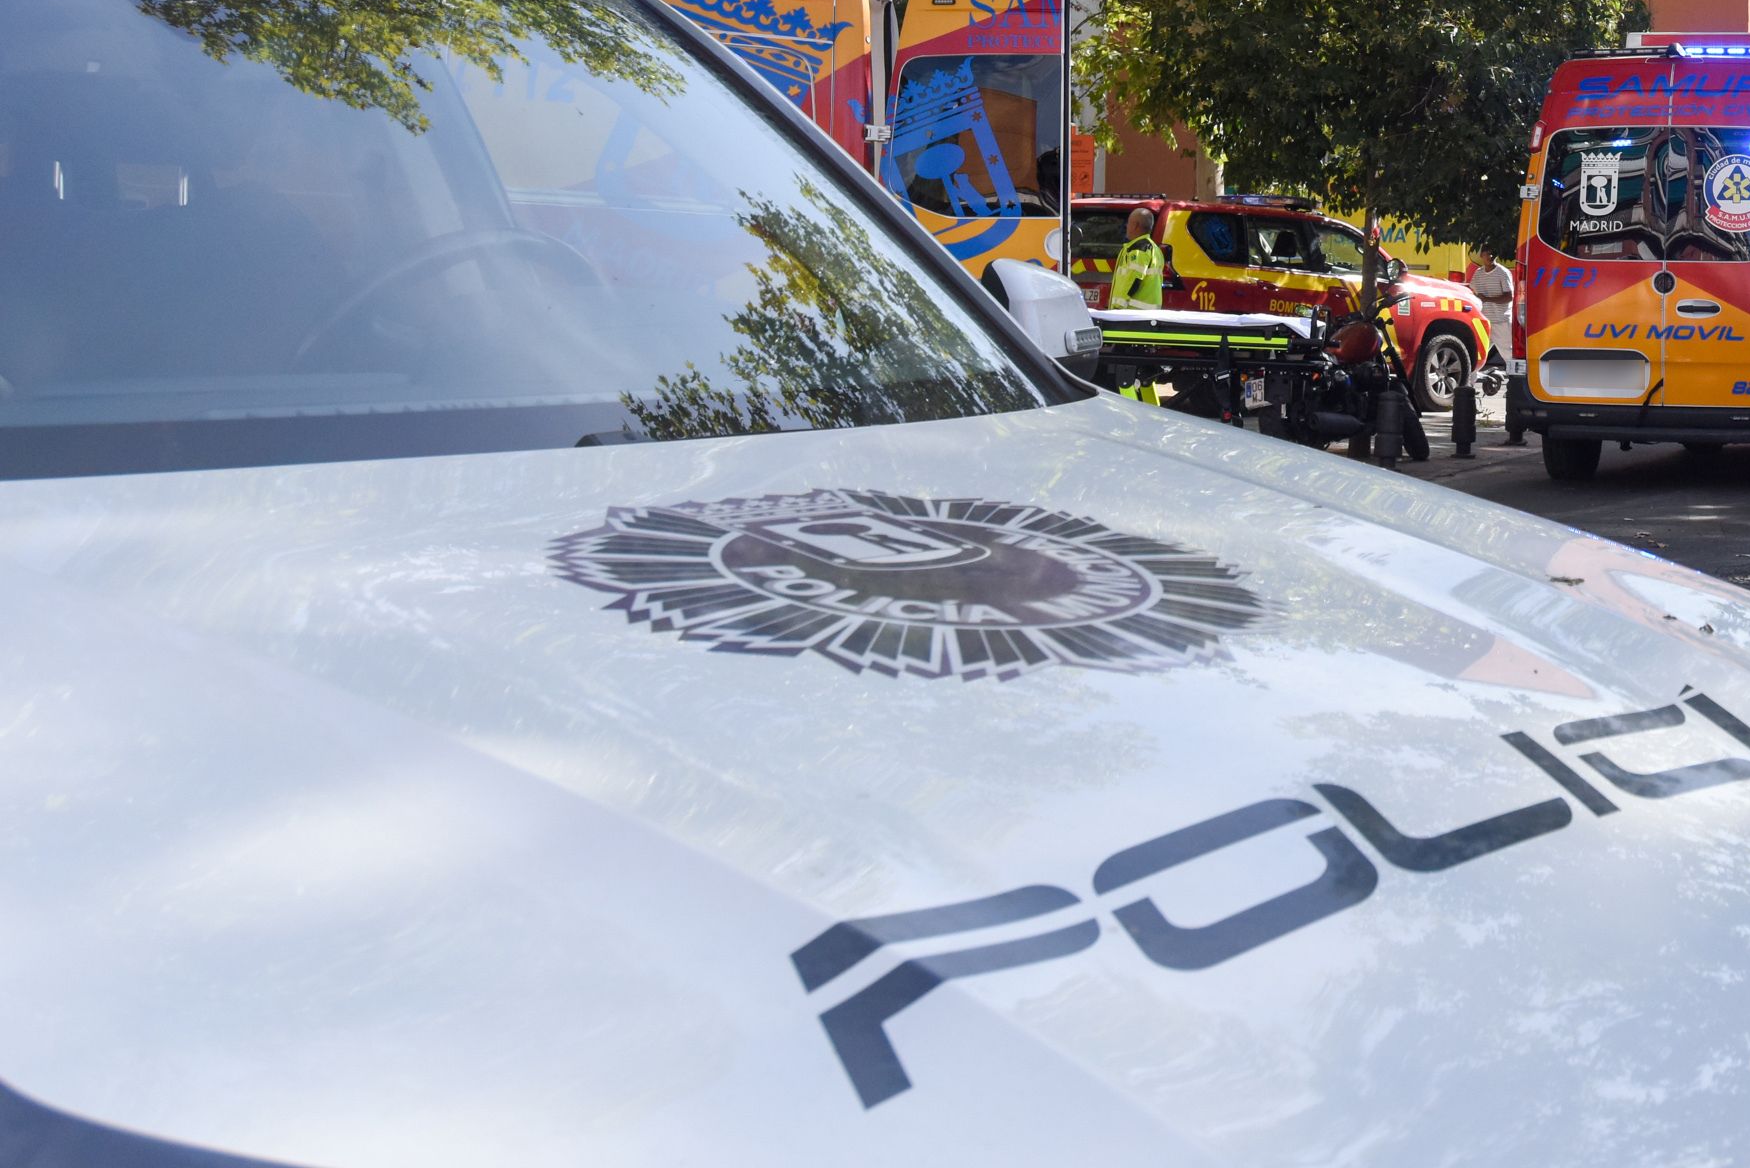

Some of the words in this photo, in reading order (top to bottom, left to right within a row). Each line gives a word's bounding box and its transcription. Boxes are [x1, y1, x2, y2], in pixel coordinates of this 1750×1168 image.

[1566, 103, 1718, 119] PROTECCIÓN
[1708, 158, 1730, 180] ciudad
[1569, 220, 1623, 232] MADRID
[1199, 291, 1216, 311] 112
[1583, 323, 1638, 339] UVI
[1646, 324, 1745, 341] MOVIL
[739, 564, 1020, 625] POLICÍA
